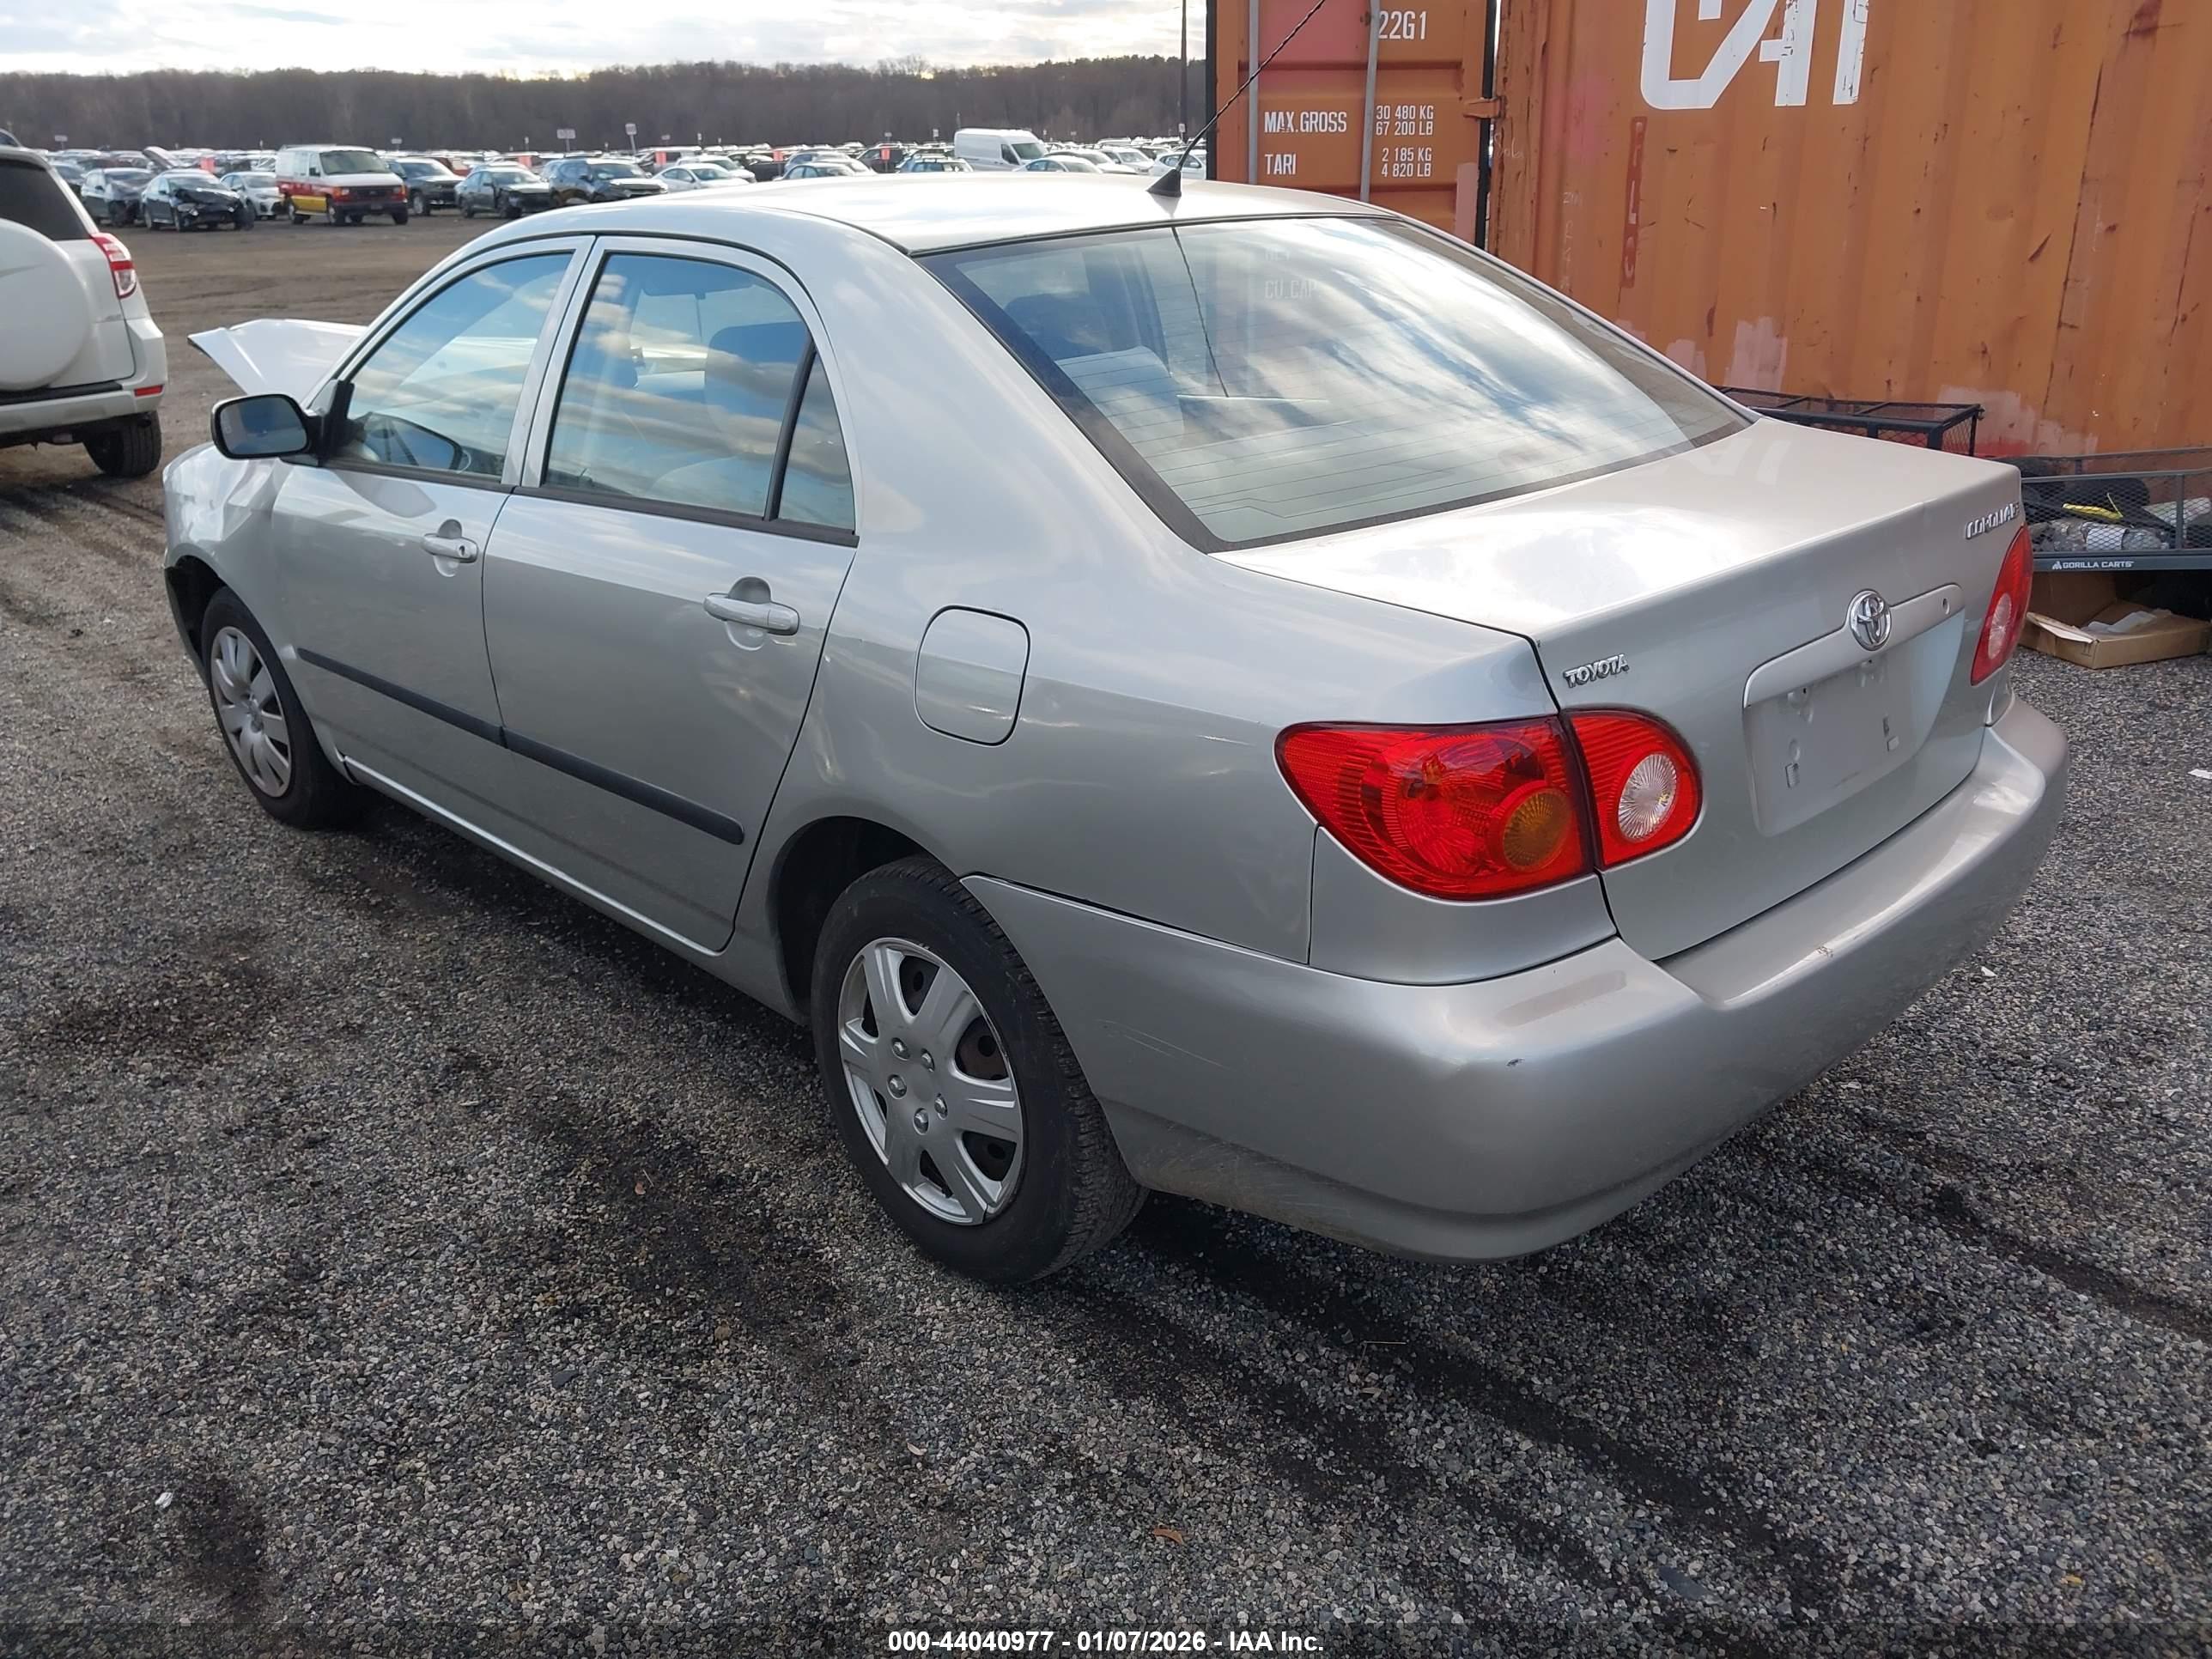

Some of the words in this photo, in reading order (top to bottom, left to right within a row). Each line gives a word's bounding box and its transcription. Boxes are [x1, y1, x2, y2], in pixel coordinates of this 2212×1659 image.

[1378, 10, 1426, 40] 22G1
[1376, 105, 1390, 119] 30
[1395, 105, 1415, 119] 480
[1419, 105, 1434, 119] KG
[1376, 121, 1389, 136] 67
[1394, 121, 1415, 136] 200
[1419, 121, 1433, 136] LB
[1382, 147, 1389, 161] 2
[1395, 147, 1414, 161] 185
[1418, 147, 1432, 161] KG
[1381, 162, 1389, 177] 4
[1392, 162, 1413, 177] 820
[1417, 162, 1431, 177] LB
[1564, 653, 1630, 688] TOYOTA
